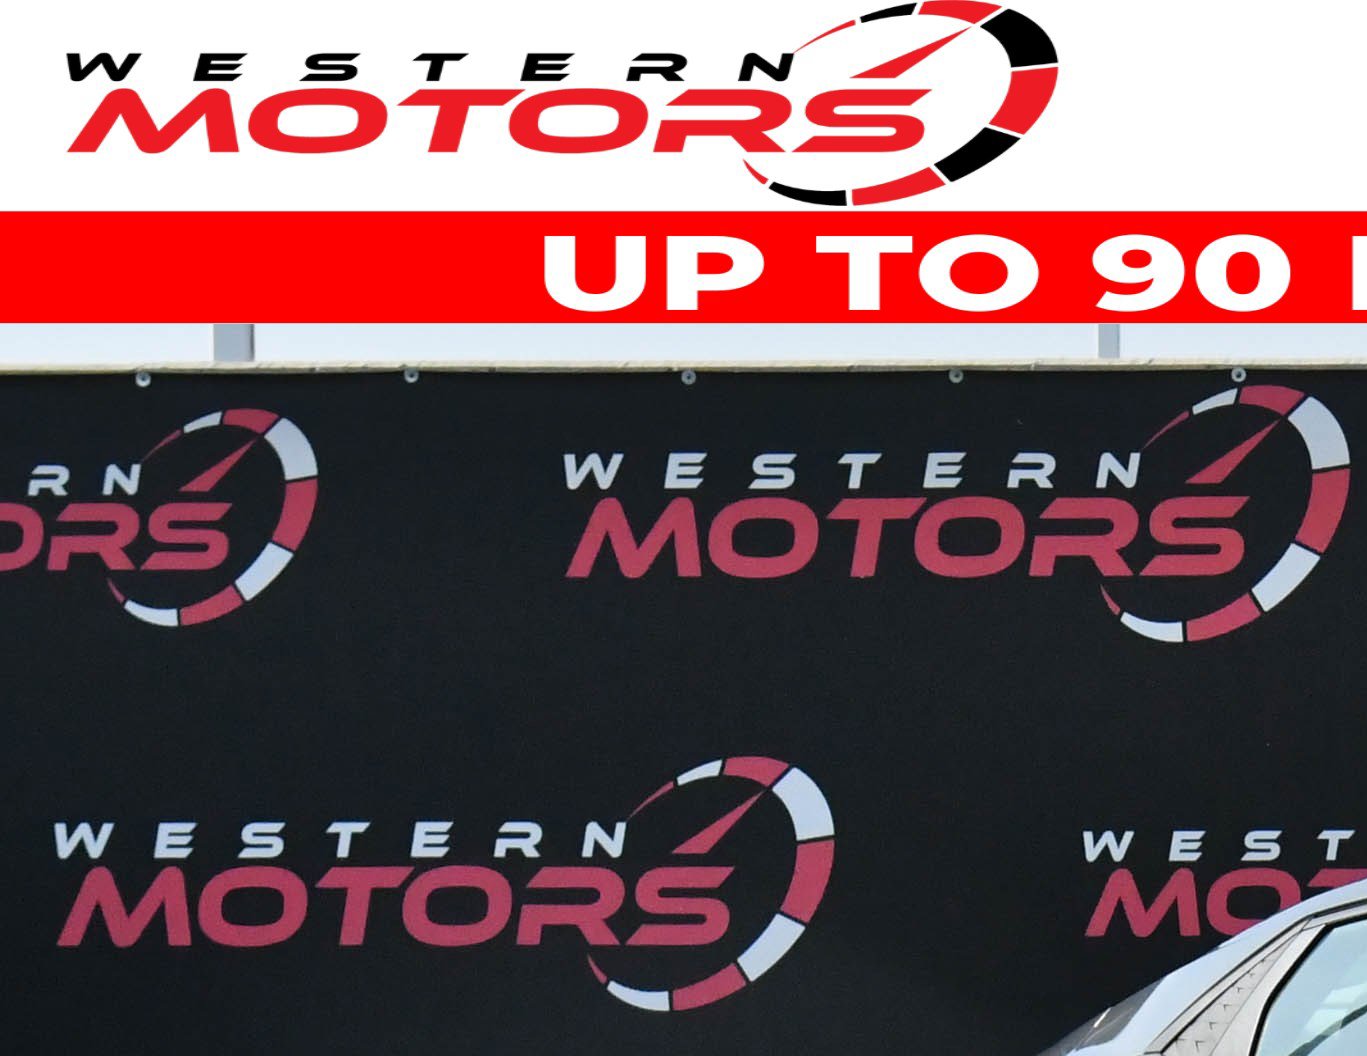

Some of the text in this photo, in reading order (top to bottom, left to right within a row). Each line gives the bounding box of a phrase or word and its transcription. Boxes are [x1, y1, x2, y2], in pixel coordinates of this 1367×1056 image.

[564, 453, 1140, 489] WESTERN
[567, 495, 1249, 578] MOTORS
[54, 822, 627, 859] WESTERN
[57, 866, 734, 947] MOTORS
